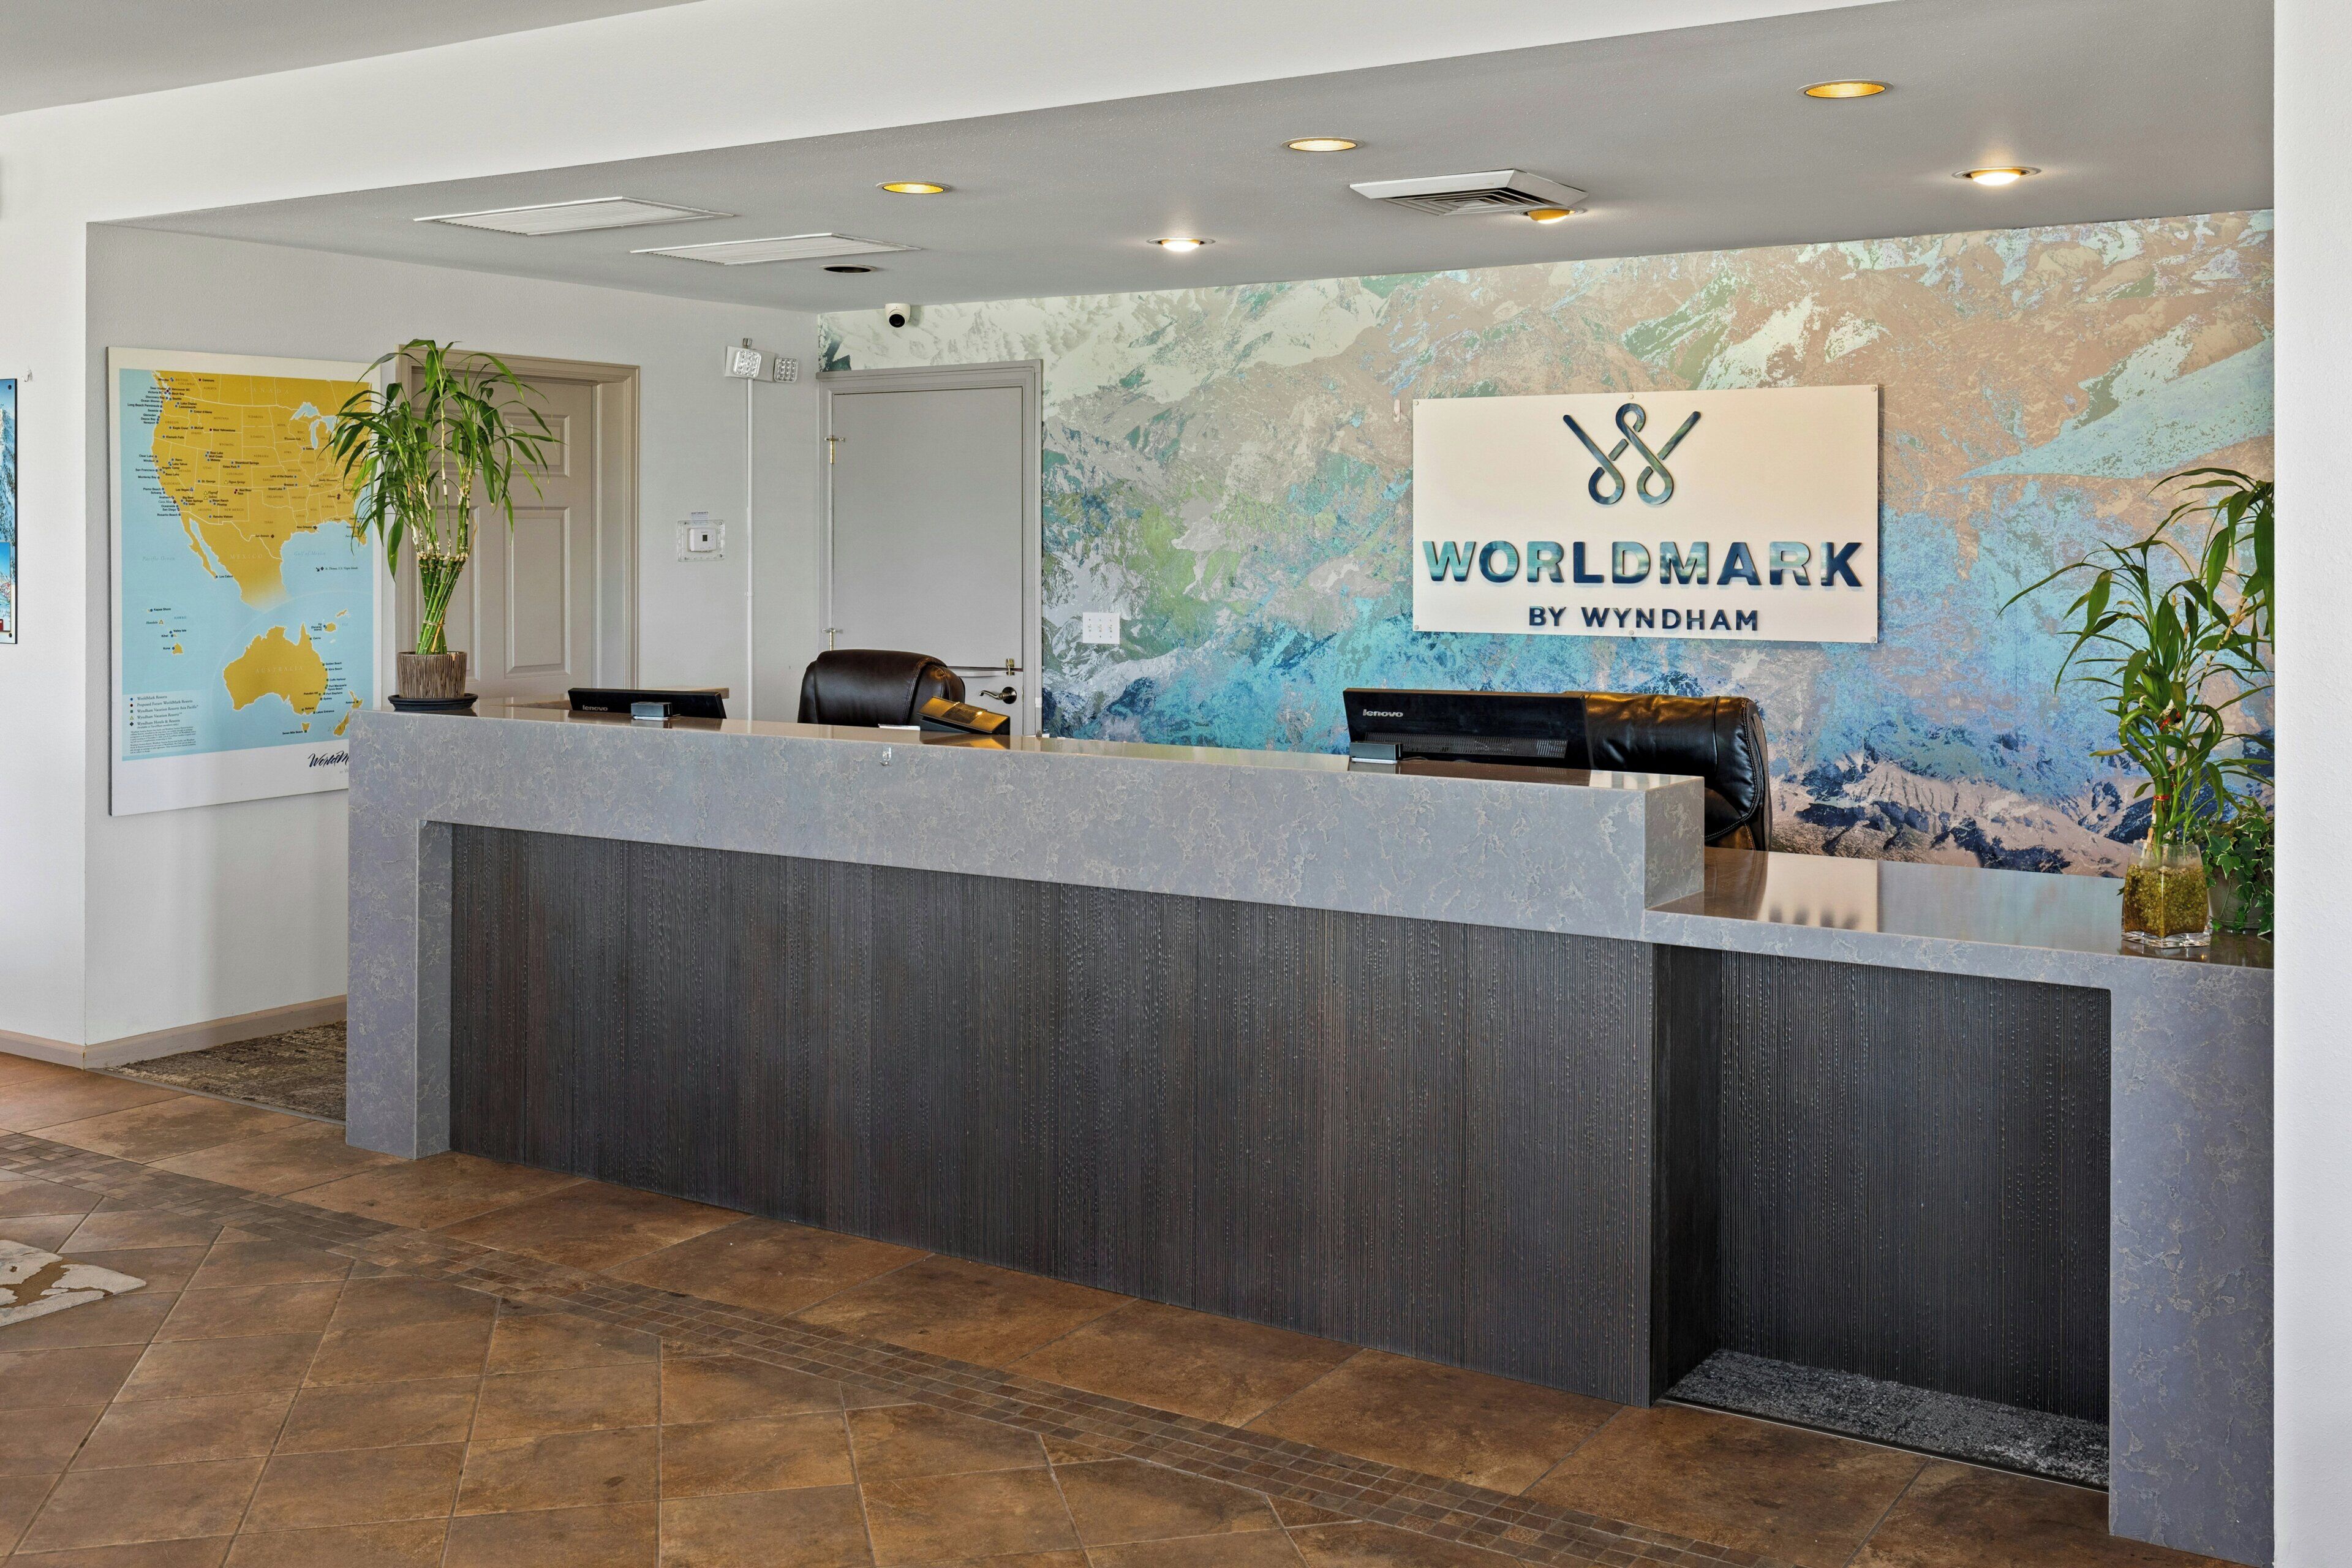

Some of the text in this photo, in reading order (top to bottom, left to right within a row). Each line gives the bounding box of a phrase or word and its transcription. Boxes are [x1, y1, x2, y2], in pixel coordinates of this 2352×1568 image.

[1423, 540, 1864, 587] WORLDMARK
[1529, 605, 1759, 631] BY WYNDHAM
[1363, 709, 1404, 717] lenovo
[307, 750, 349, 767] WorldM
